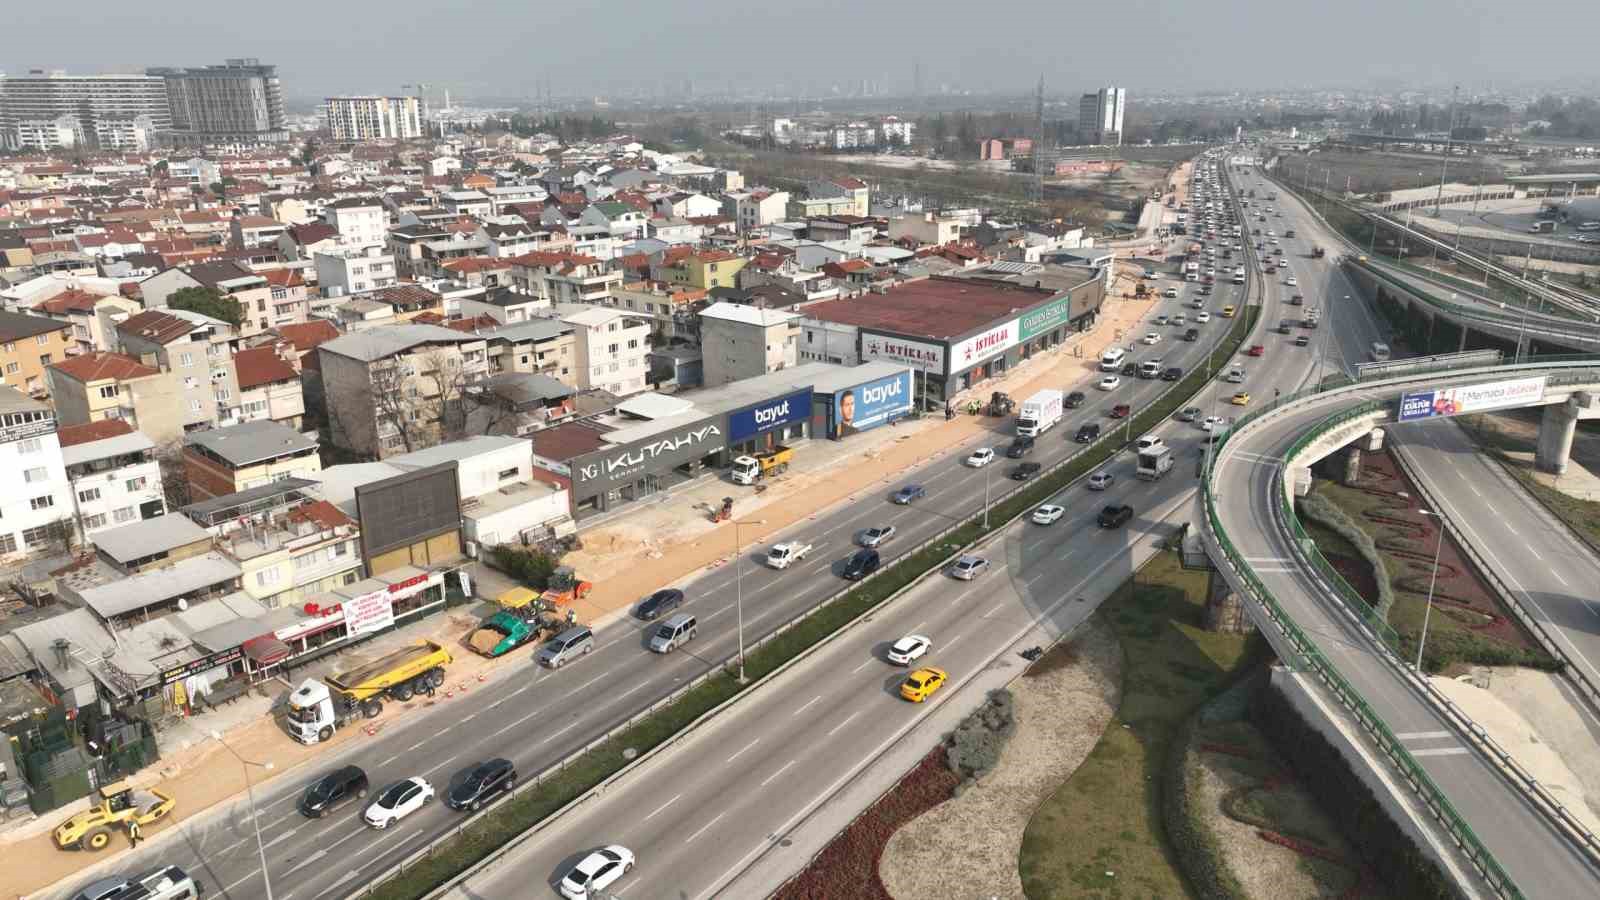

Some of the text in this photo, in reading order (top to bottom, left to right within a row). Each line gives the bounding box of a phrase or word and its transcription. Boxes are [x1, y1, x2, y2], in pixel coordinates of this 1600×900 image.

[863, 377, 902, 404] bayut
[754, 400, 790, 423] bayut
[580, 464, 598, 482] NG
